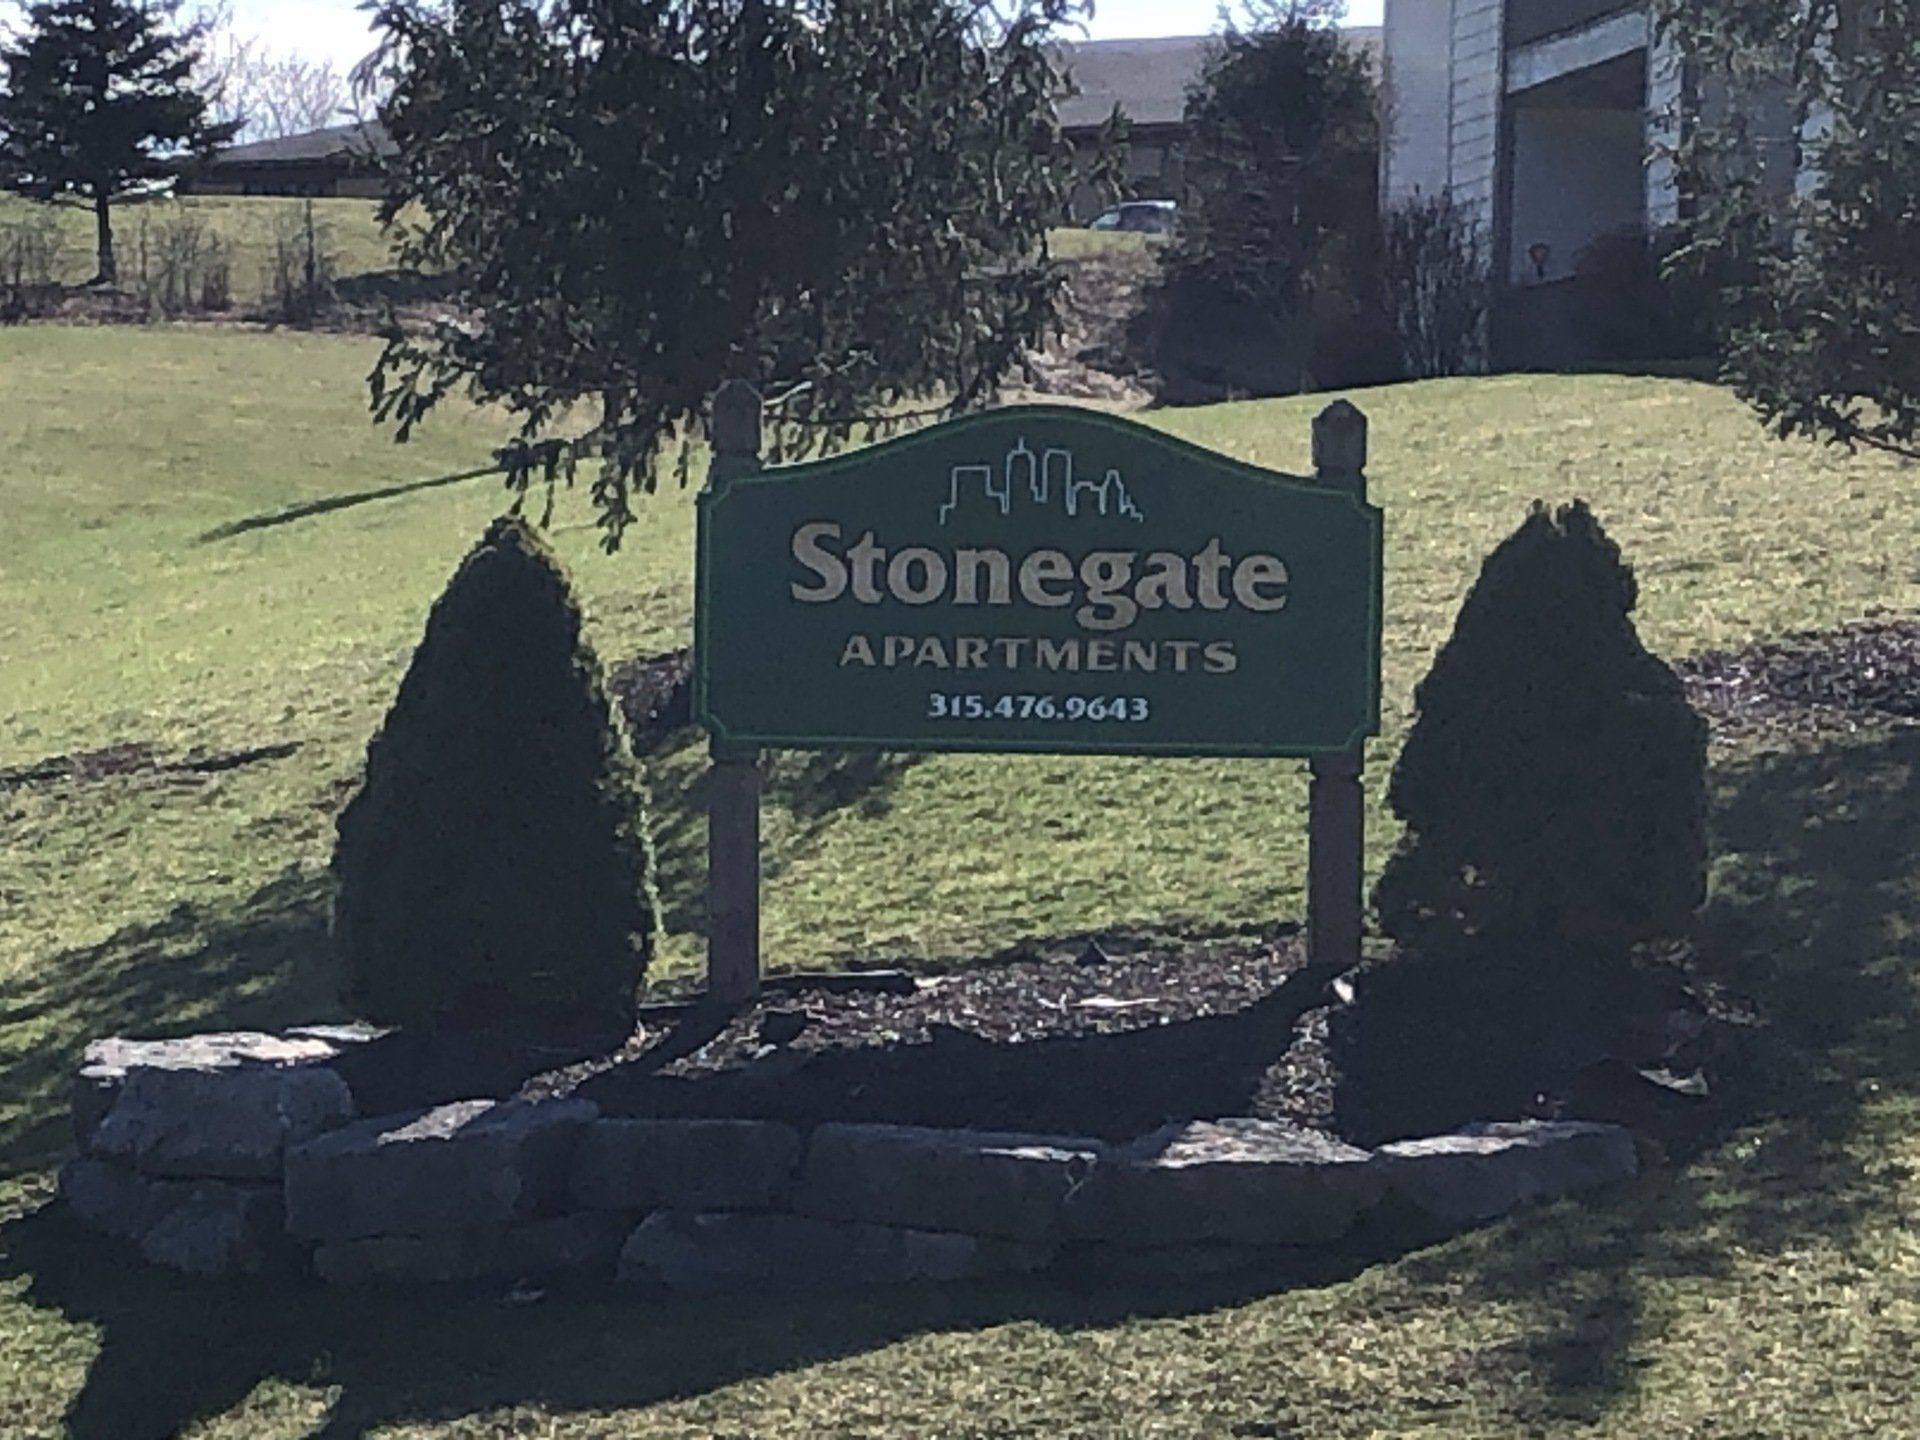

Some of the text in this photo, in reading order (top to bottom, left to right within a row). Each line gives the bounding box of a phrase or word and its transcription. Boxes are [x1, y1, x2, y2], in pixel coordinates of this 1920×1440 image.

[791, 522, 1289, 631] Stonegate
[840, 635, 1239, 674] APARTMENTS
[927, 692, 1150, 722] 315.476.9643
